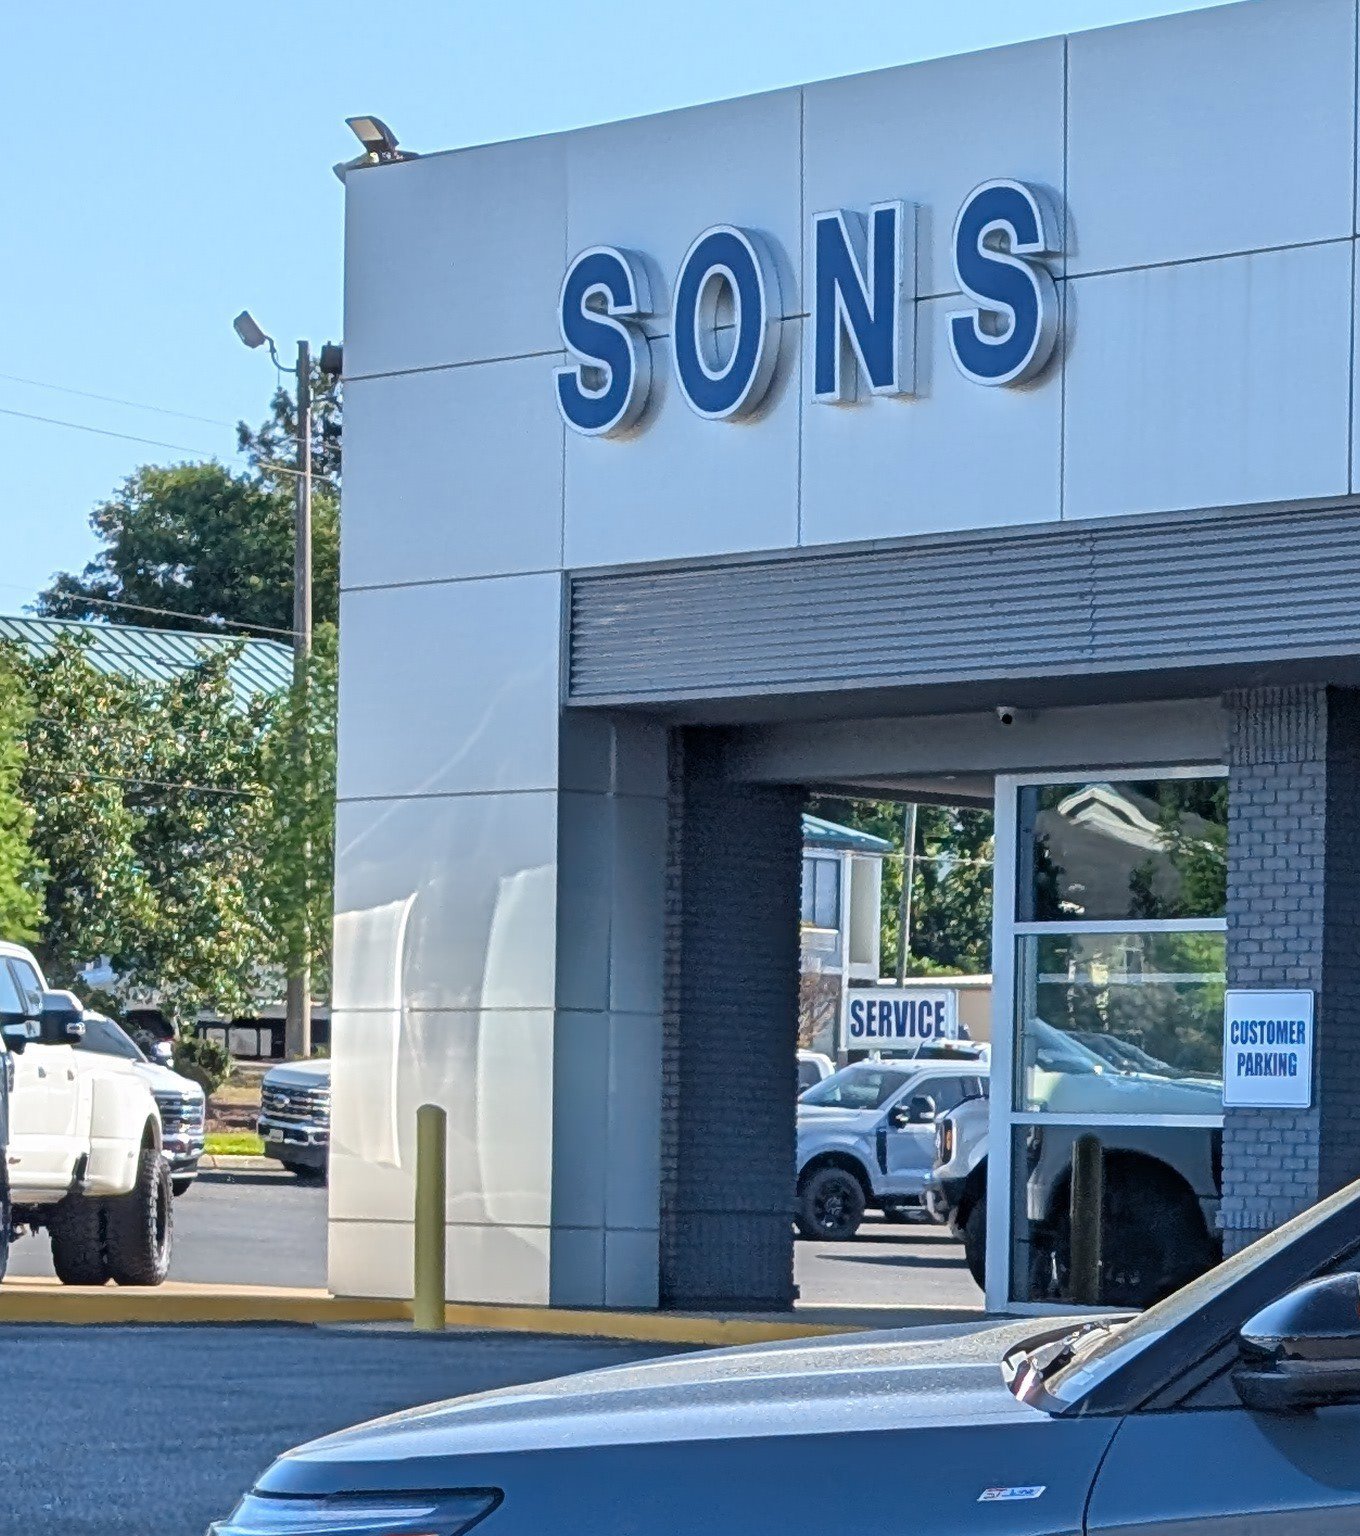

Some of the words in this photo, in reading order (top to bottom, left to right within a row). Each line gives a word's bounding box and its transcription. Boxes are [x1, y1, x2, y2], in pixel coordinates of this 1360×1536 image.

[554, 178, 1058, 436] SONS
[850, 999, 946, 1038] SERVICE
[1230, 1020, 1306, 1045] CUSTOMER
[1236, 1052, 1298, 1077] PARKING
